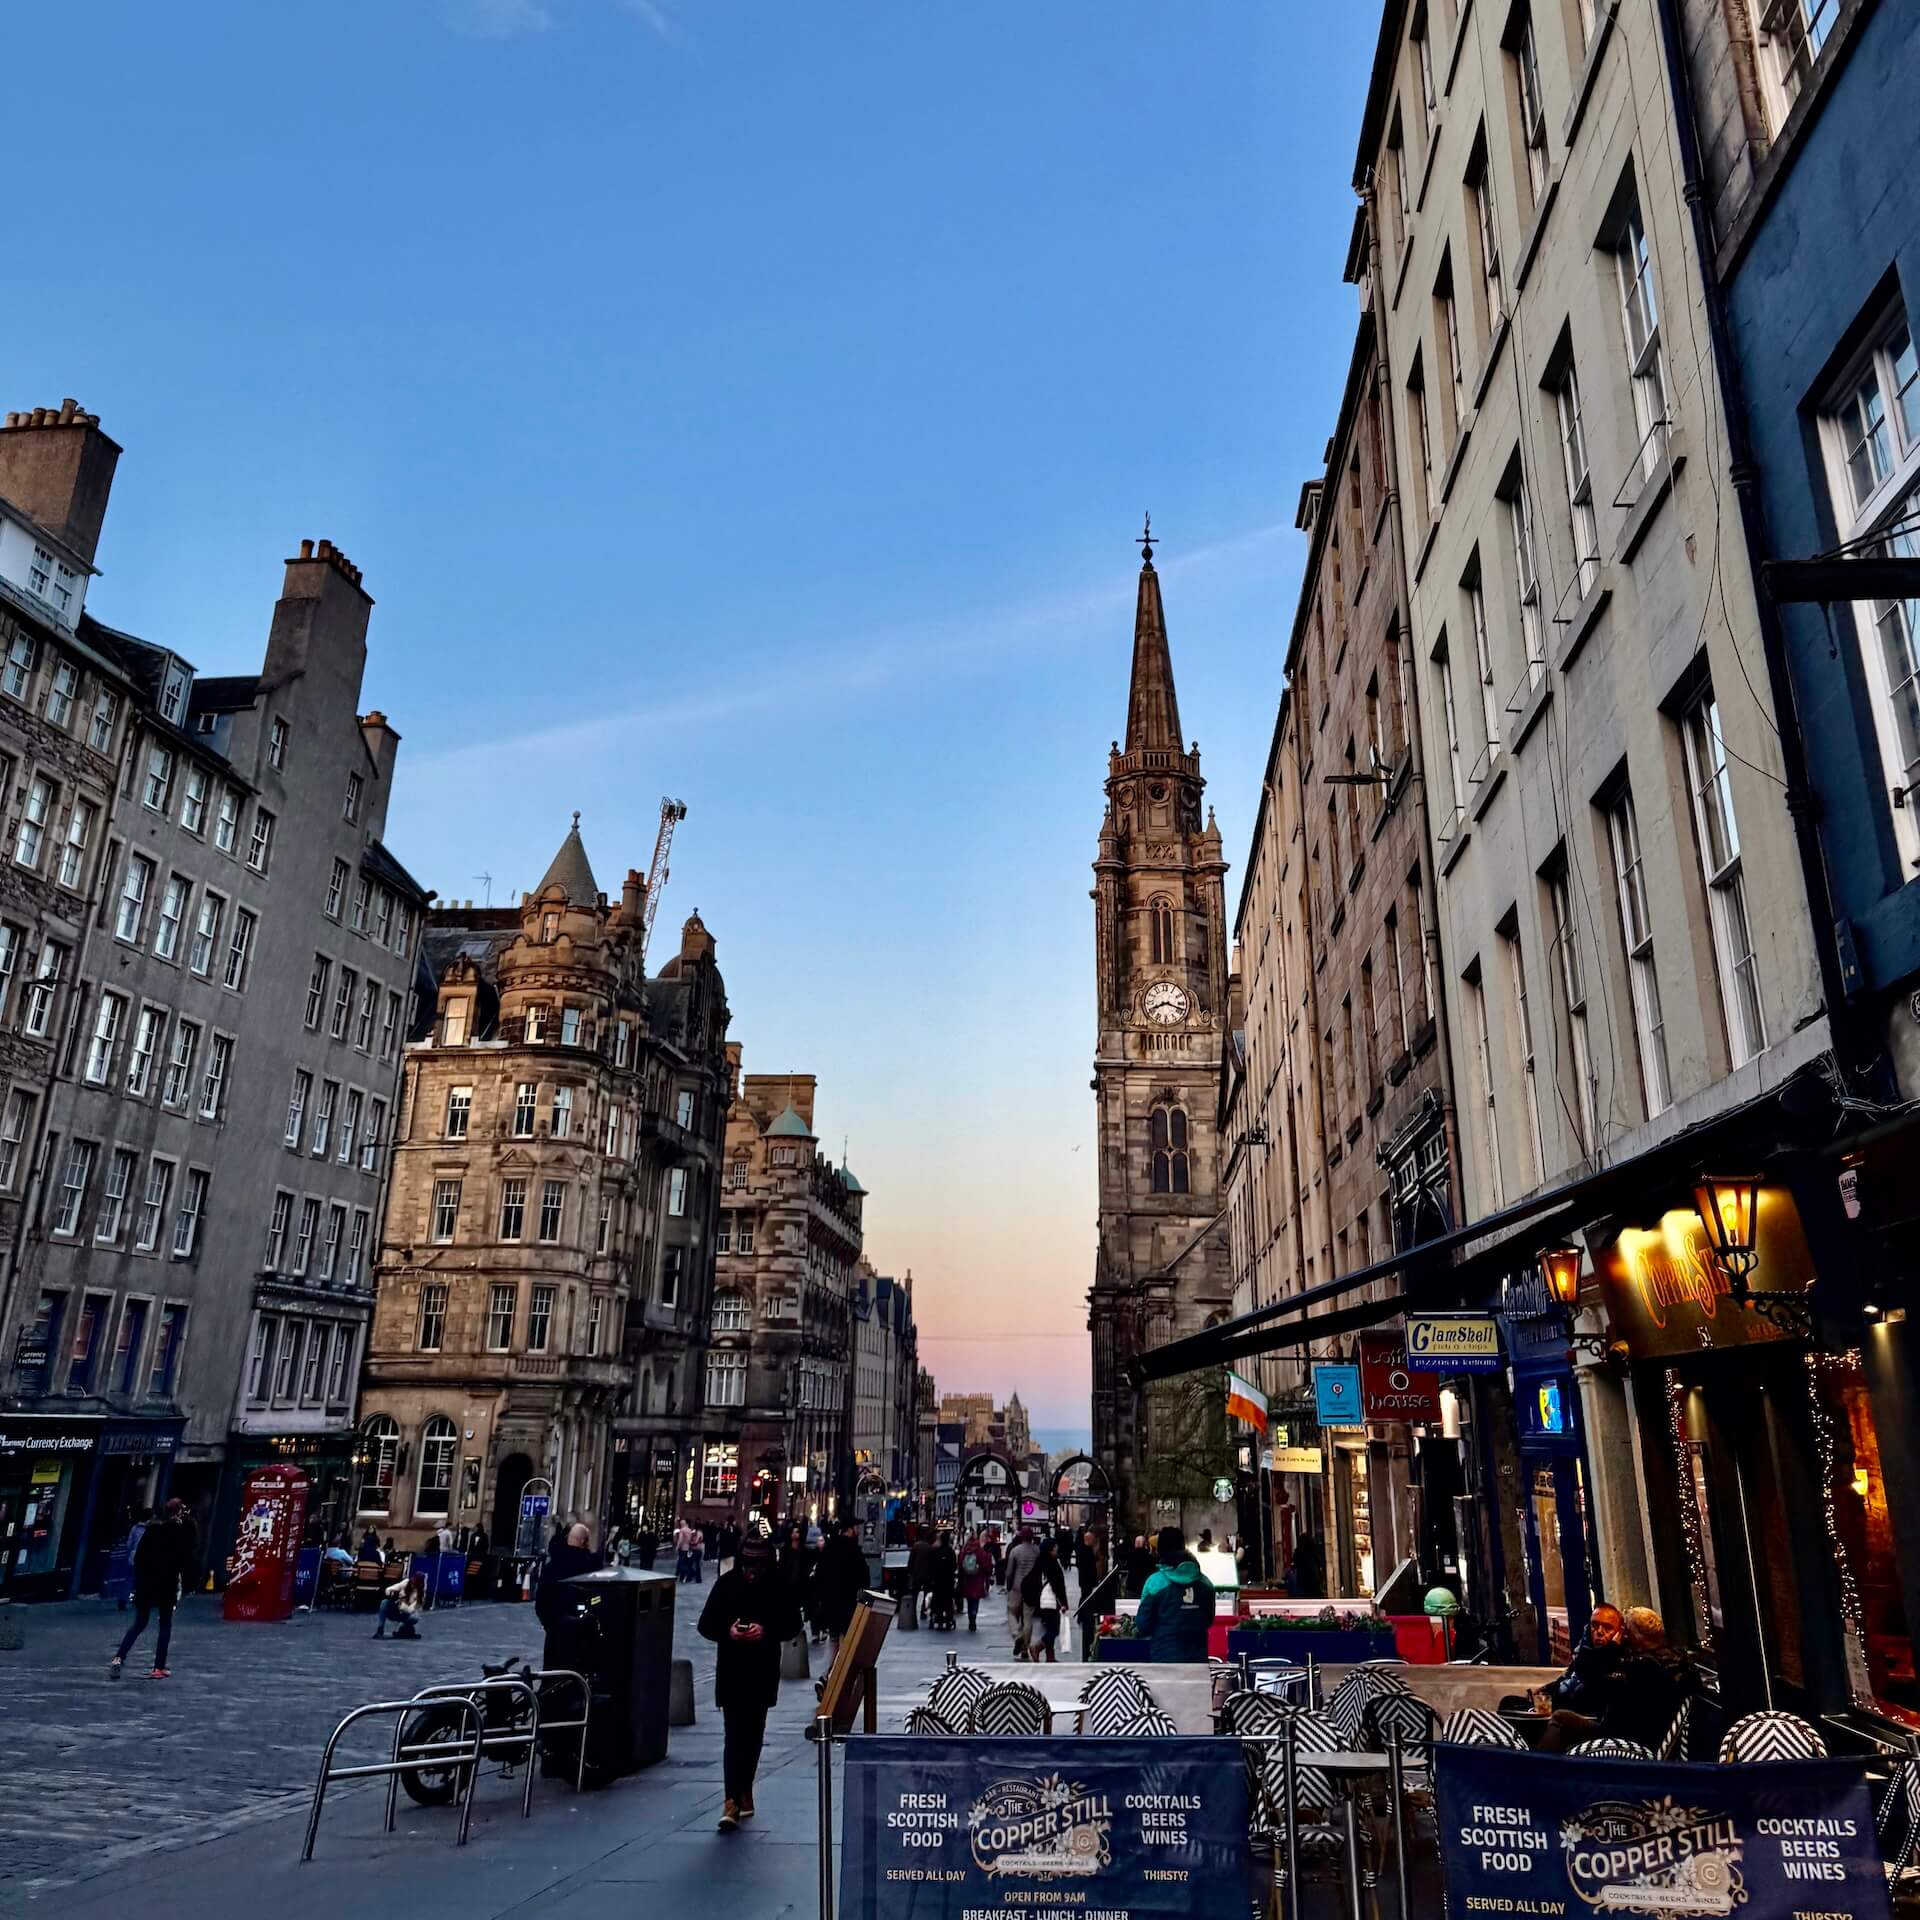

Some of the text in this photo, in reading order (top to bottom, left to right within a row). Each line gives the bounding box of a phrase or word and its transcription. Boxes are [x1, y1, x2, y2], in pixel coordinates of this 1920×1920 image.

[1412, 1322, 1493, 1351] ClamShell
[26, 1436, 60, 1451] Currency
[59, 1436, 94, 1450] Exchange
[900, 1793, 947, 1809] FRESH
[1004, 1798, 1023, 1814] THE
[1125, 1795, 1202, 1810] COCKTAILS
[887, 1812, 959, 1829] SCOTTISH
[977, 1795, 1113, 1851] COPPER STILL
[1141, 1812, 1187, 1827] BEERS
[1472, 1805, 1531, 1826] FRESH
[1603, 1819, 1628, 1838] THE
[1756, 1818, 1858, 1837] COCKTAILS
[902, 1831, 944, 1847] FOOD
[1141, 1830, 1188, 1845] WINES
[1460, 1827, 1549, 1850] SCOTTISH
[1574, 1818, 1745, 1879] COPPER STILL
[1780, 1839, 1841, 1858] BEERS
[1481, 1851, 1533, 1872] FOOD
[886, 1870, 966, 1881] SERVED ALL DAY
[1143, 1869, 1189, 1881] THIRSTY?
[1783, 1862, 1847, 1881] WINES
[1004, 1891, 1086, 1902] OPEN FROM 9AM
[1608, 1892, 1654, 1902] COCKTAILS
[1465, 1896, 1566, 1915] SERVED ALL DAY
[962, 1909, 1129, 1920] BREAKFAST LUNCH DINNER
